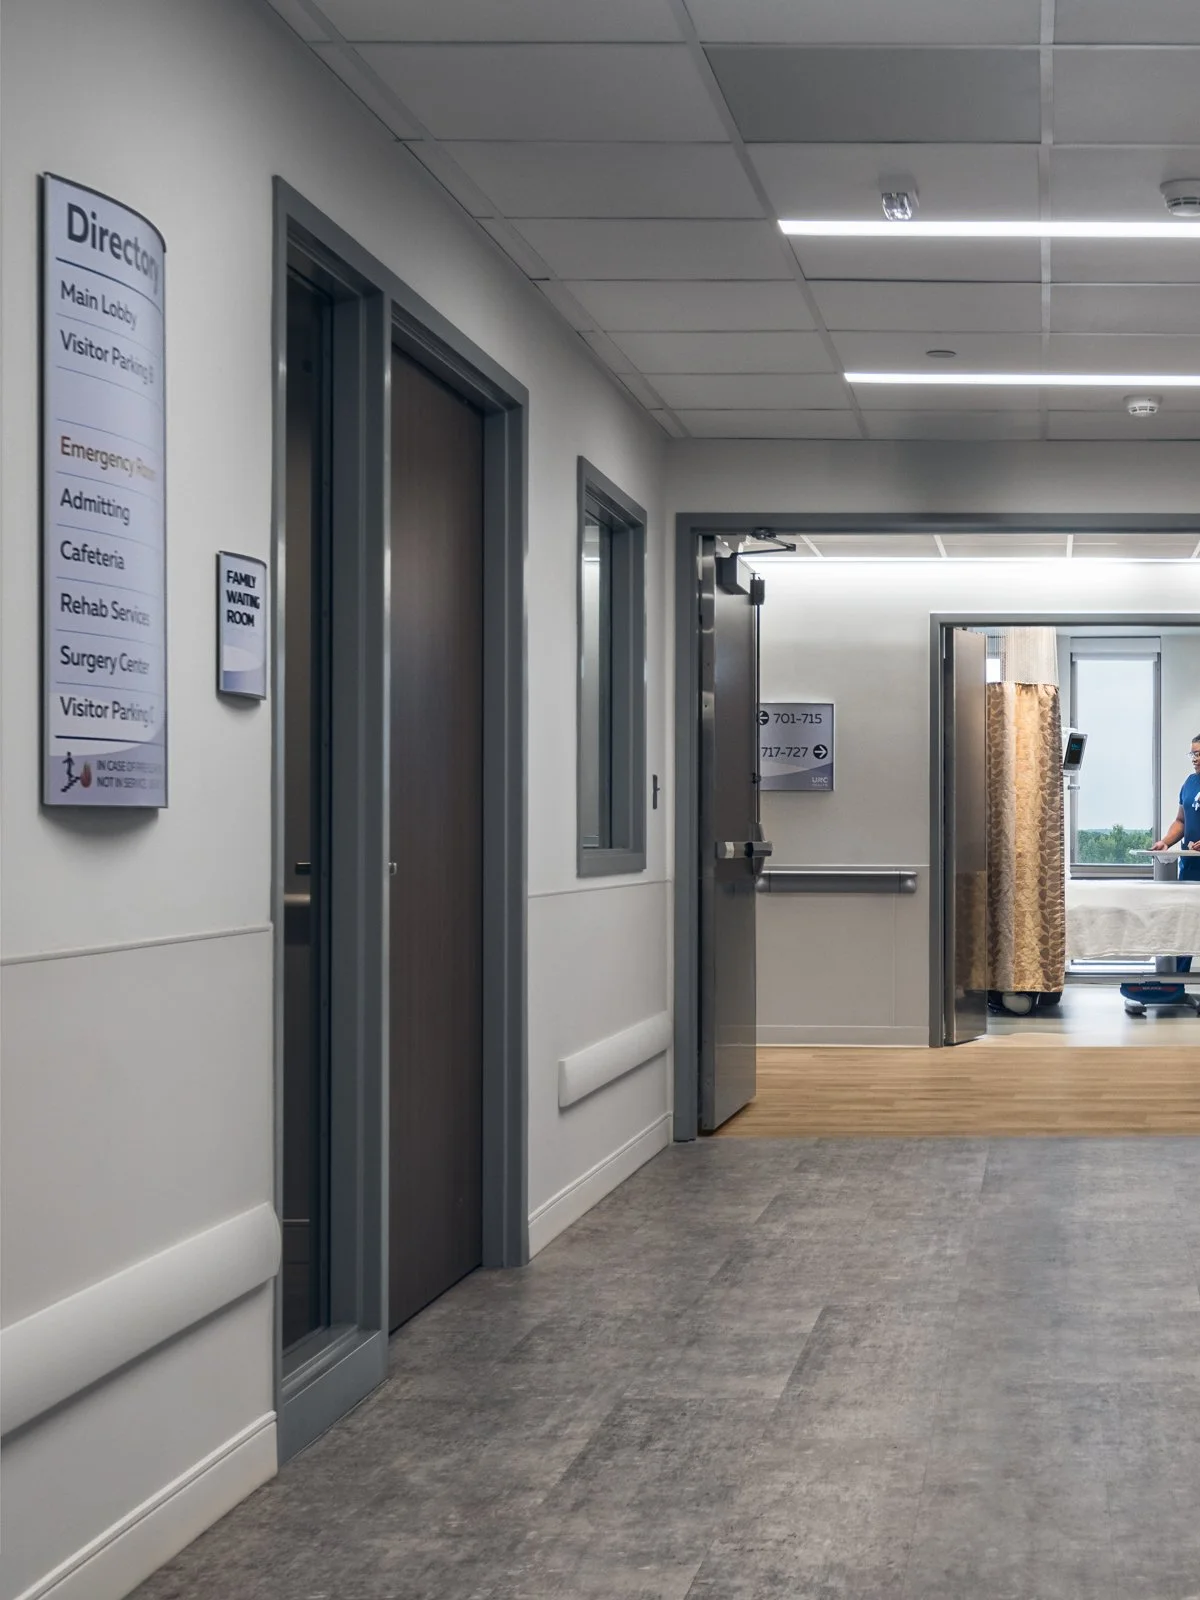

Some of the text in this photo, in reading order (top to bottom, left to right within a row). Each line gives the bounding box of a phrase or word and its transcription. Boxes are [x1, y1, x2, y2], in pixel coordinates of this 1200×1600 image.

[67, 202, 159, 295] Directory
[60, 280, 136, 331] Main Lobby
[60, 329, 109, 362] Visitor
[111, 347, 149, 385] Parking
[61, 435, 133, 478] Emergency
[60, 488, 130, 526] Admitting
[60, 540, 125, 570] Cafeteria
[227, 570, 257, 589] FAMILY
[60, 592, 150, 627] Rehab Services
[226, 590, 260, 610] WAITING
[227, 609, 255, 627] ROOM
[60, 645, 150, 675] Surgery Center
[60, 696, 108, 719] Visitor
[111, 700, 149, 728] Parking
[773, 713, 822, 724] 701-715
[96, 760, 106, 771] IN
[761, 746, 808, 758] 717-727
[97, 776, 114, 788] NOT
